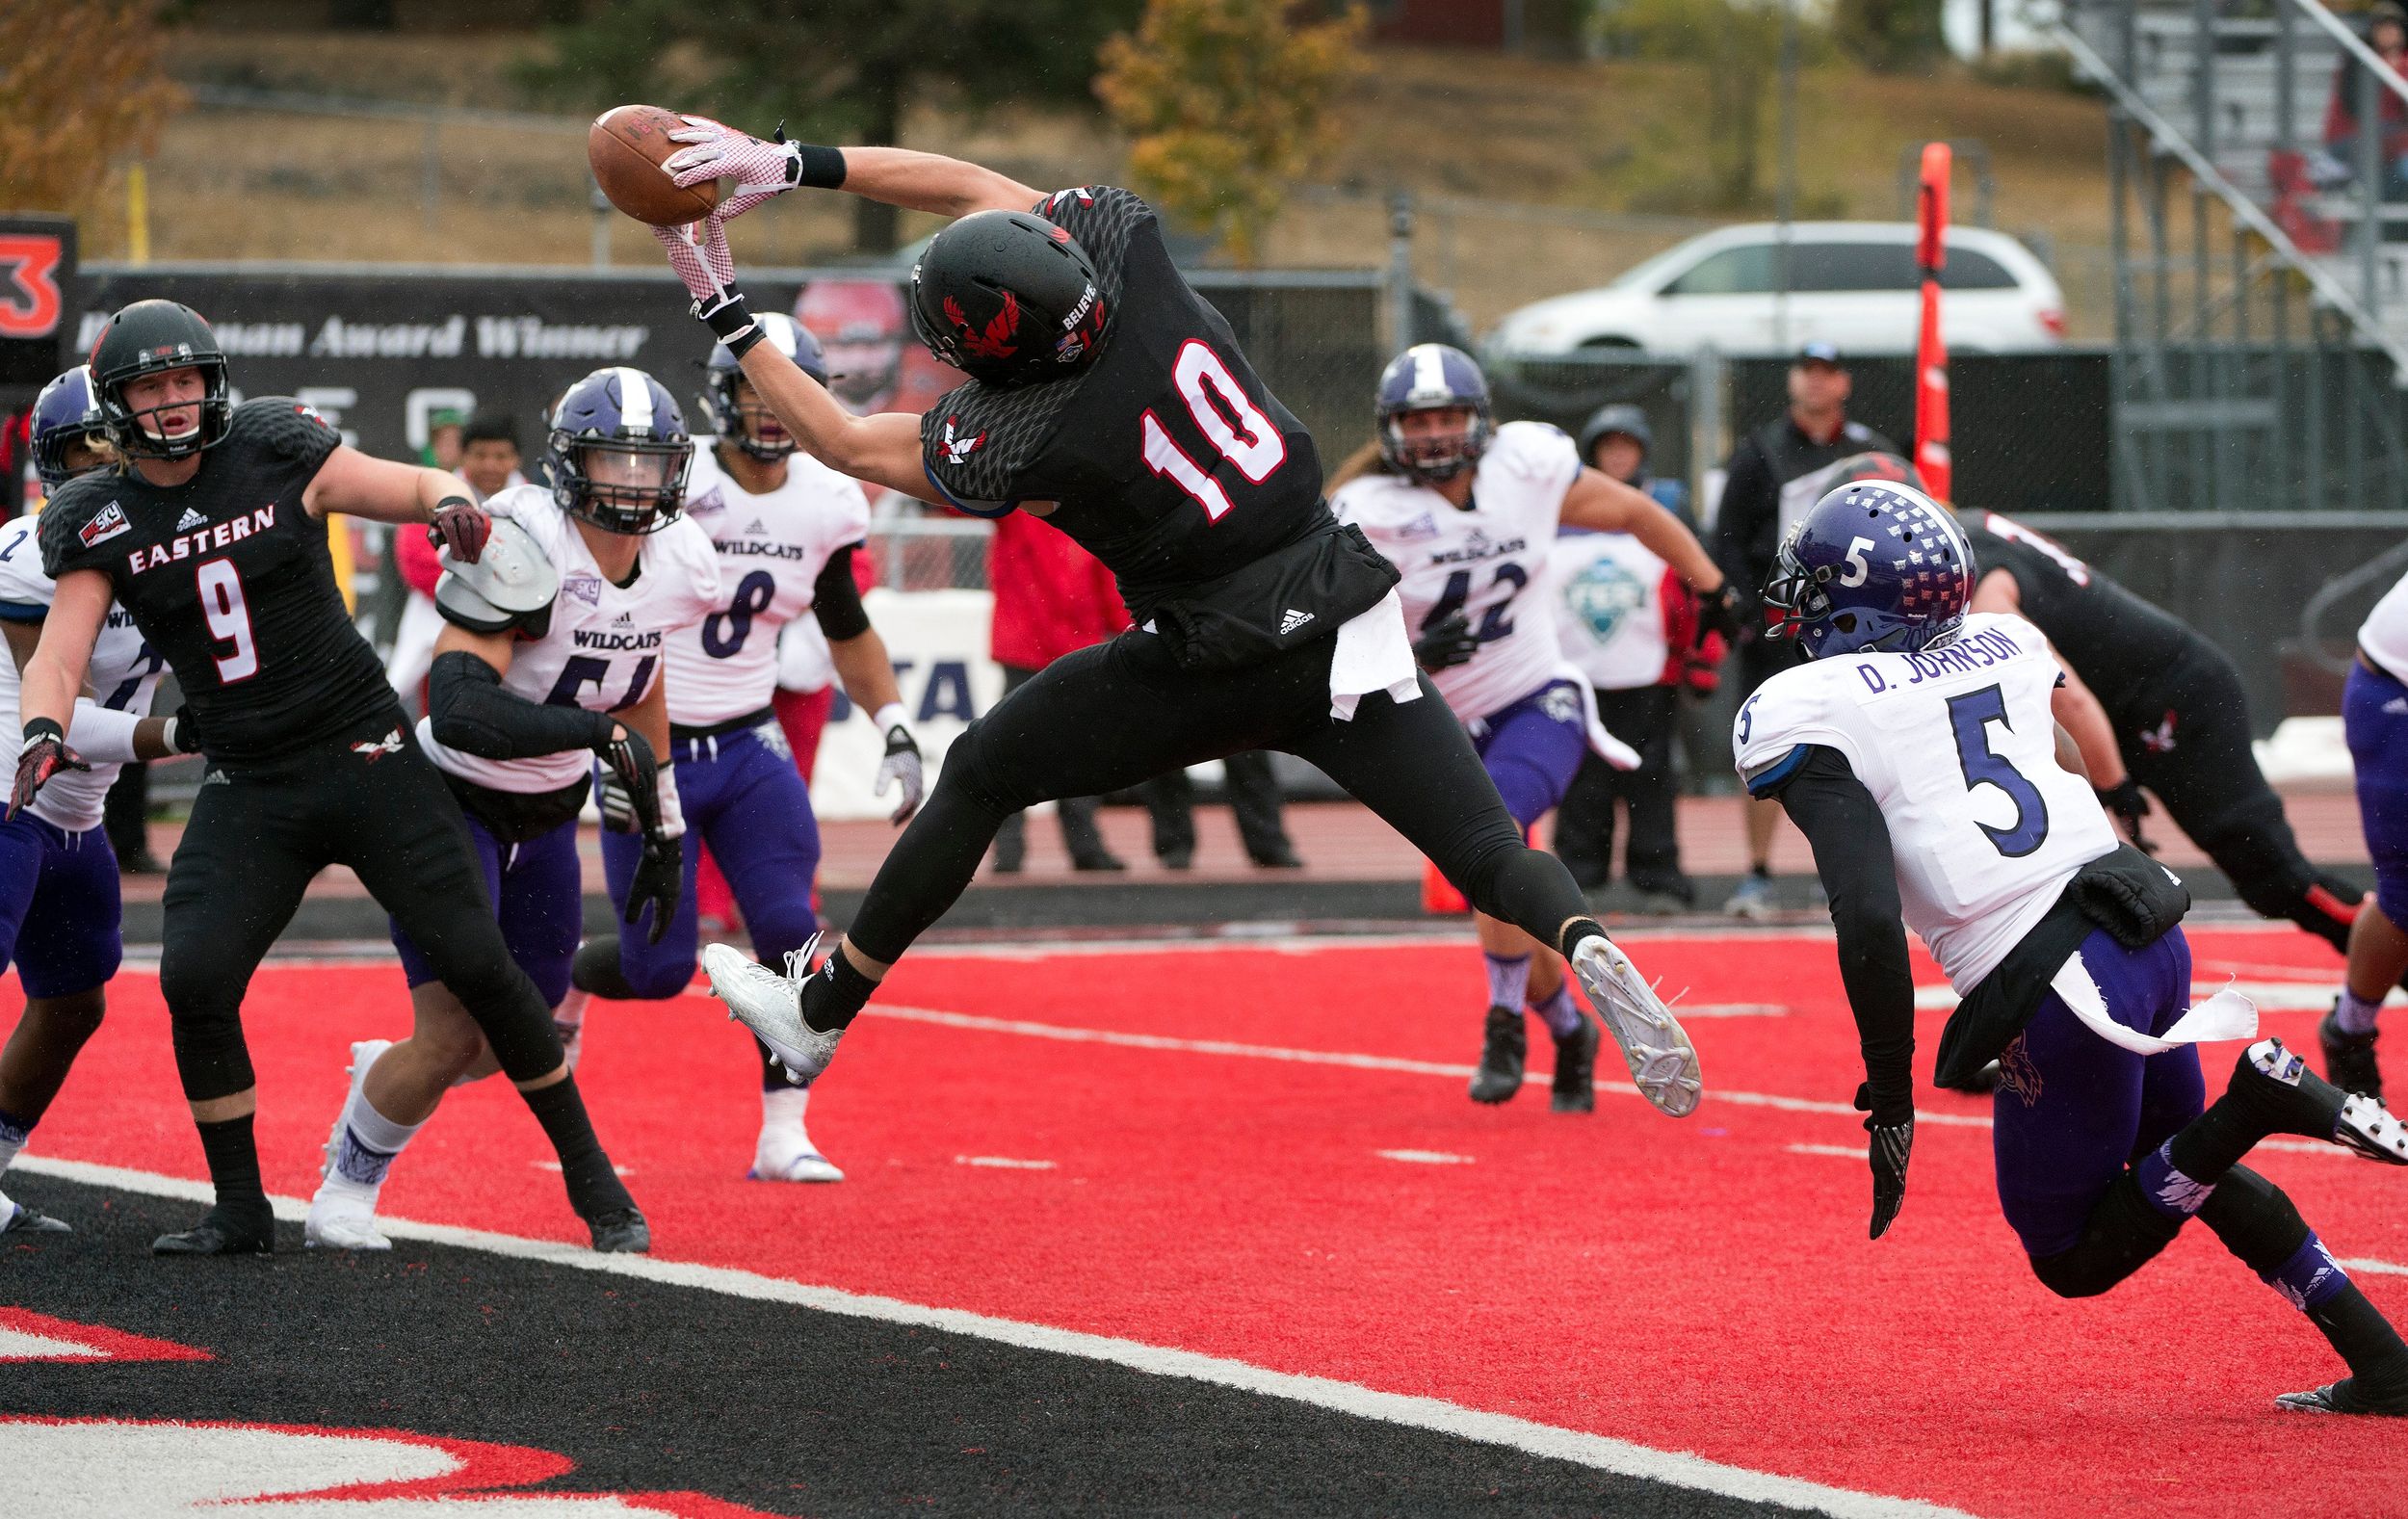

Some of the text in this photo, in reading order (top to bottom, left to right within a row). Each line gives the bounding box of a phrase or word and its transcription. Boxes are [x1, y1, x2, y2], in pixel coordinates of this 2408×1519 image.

[0, 235, 62, 336] 3
[311, 314, 467, 357] Award
[477, 314, 649, 358] Winner
[1140, 338, 1287, 527] 10
[94, 504, 121, 531] SKY
[128, 504, 275, 576] EASTERN
[712, 540, 803, 562] WILDCATS
[1840, 536, 1876, 589] 5
[196, 555, 260, 684] 9
[573, 629, 662, 651] WILDCATS
[702, 570, 775, 659] 8
[1280, 612, 1315, 635] adidas
[1856, 627, 2023, 694] D. JOHNSON
[1738, 693, 1762, 746] 5
[1945, 682, 2050, 858] 5
